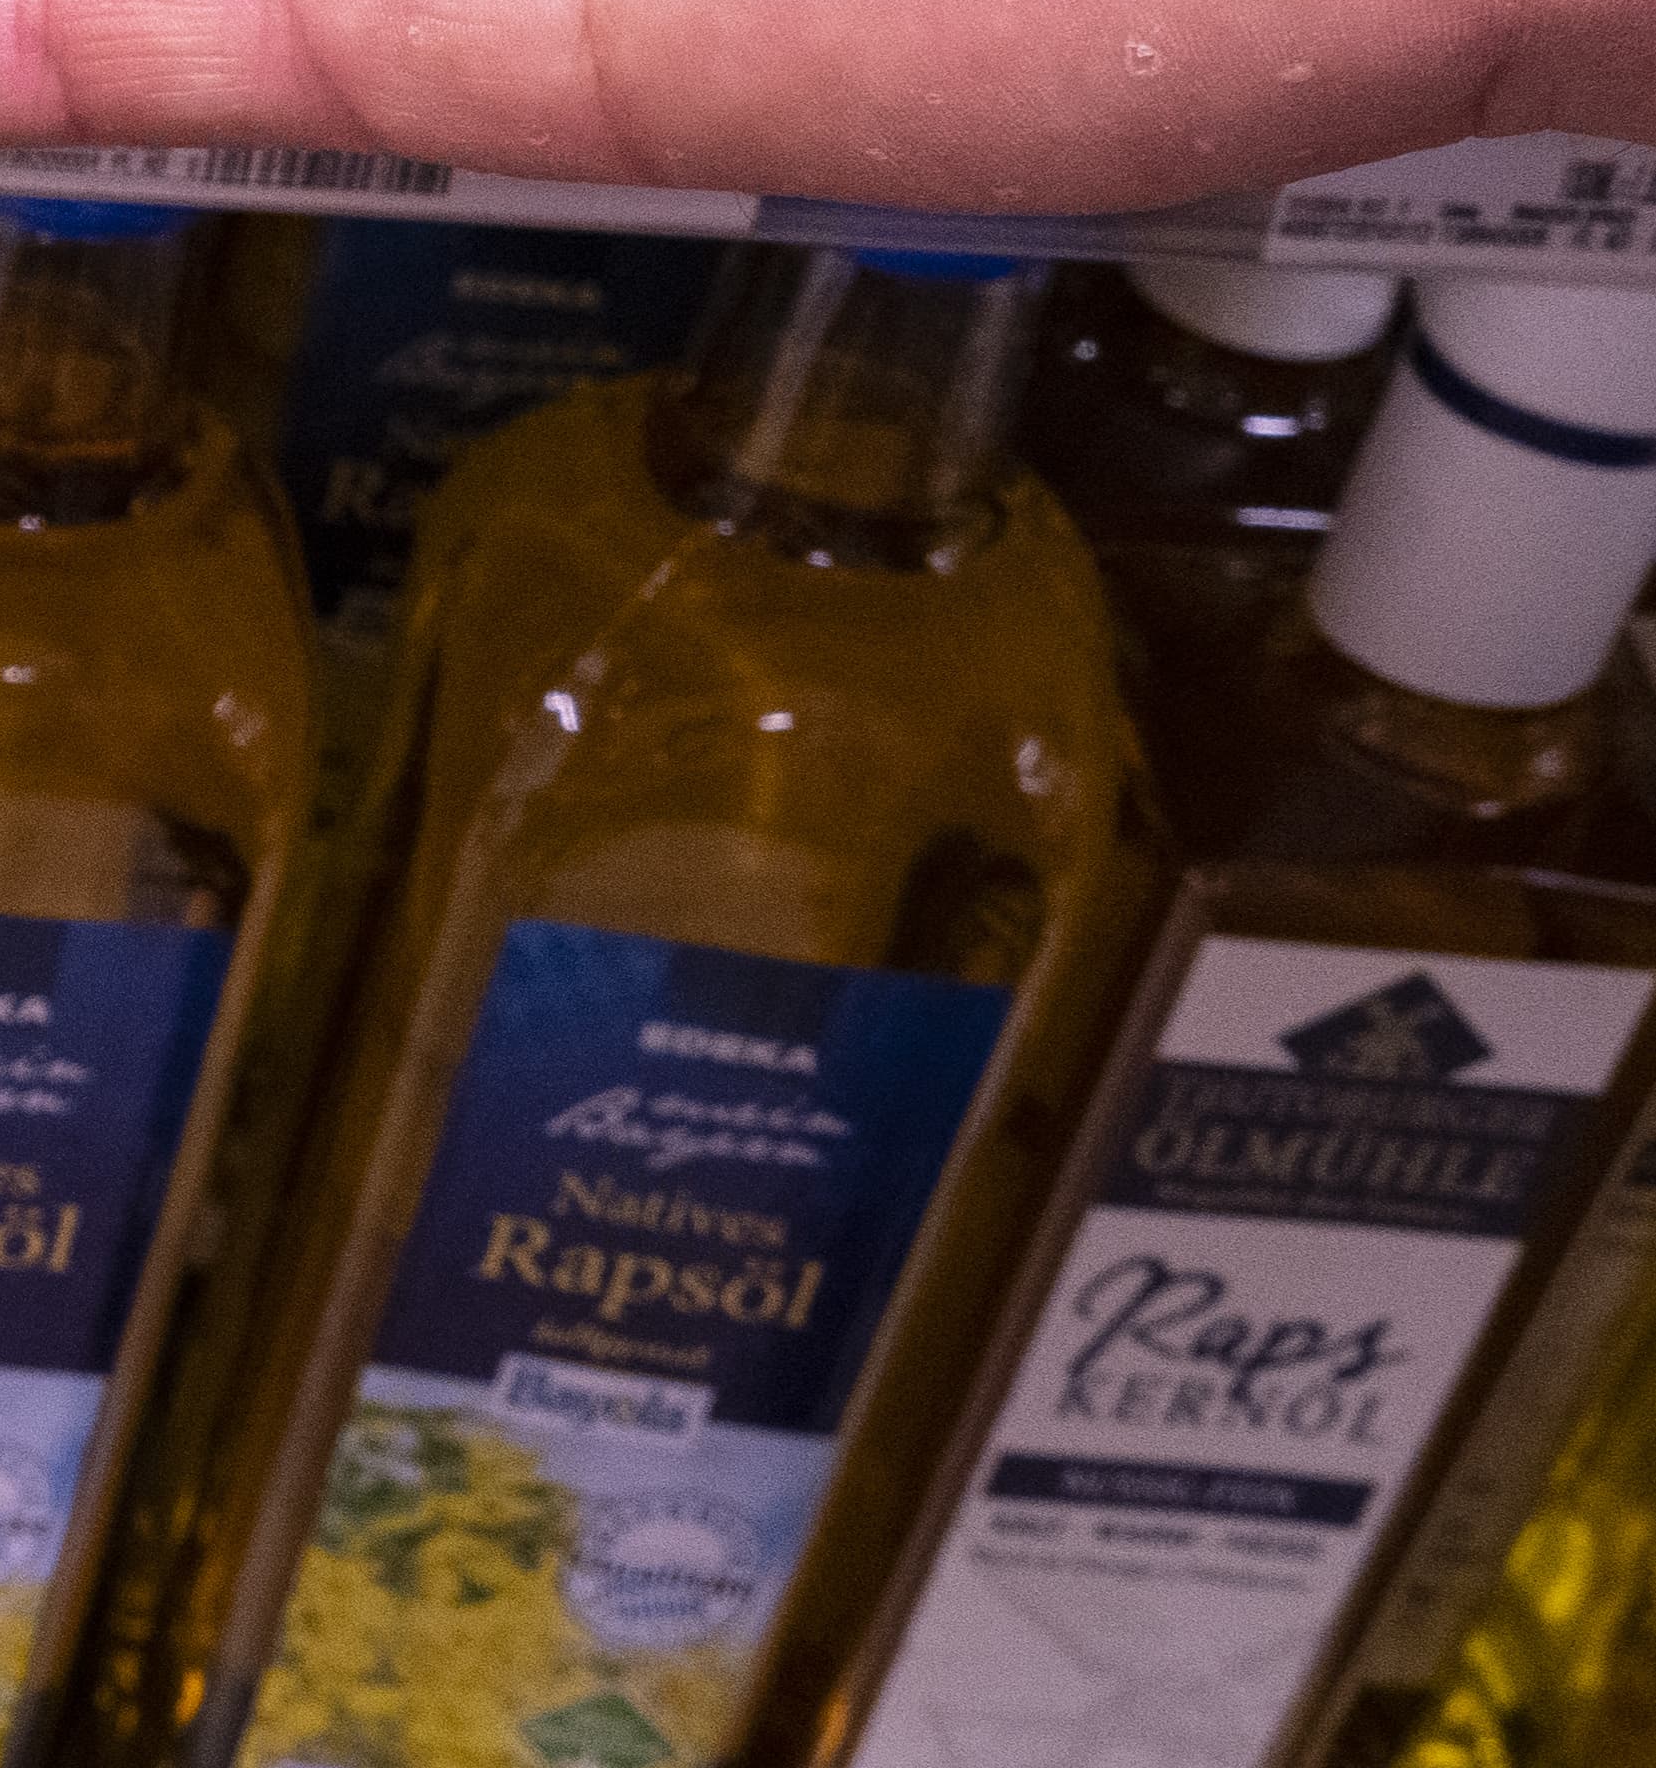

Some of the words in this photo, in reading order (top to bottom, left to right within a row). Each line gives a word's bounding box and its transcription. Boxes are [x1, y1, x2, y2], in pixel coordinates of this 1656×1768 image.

[1132, 1108, 1527, 1201] ÖLMÜHLE
[554, 1171, 788, 1248] Natives
[476, 1212, 826, 1331] Rapsöl
[1068, 1254, 1423, 1388] Raps
[1053, 1360, 1384, 1446] KERNÖL
